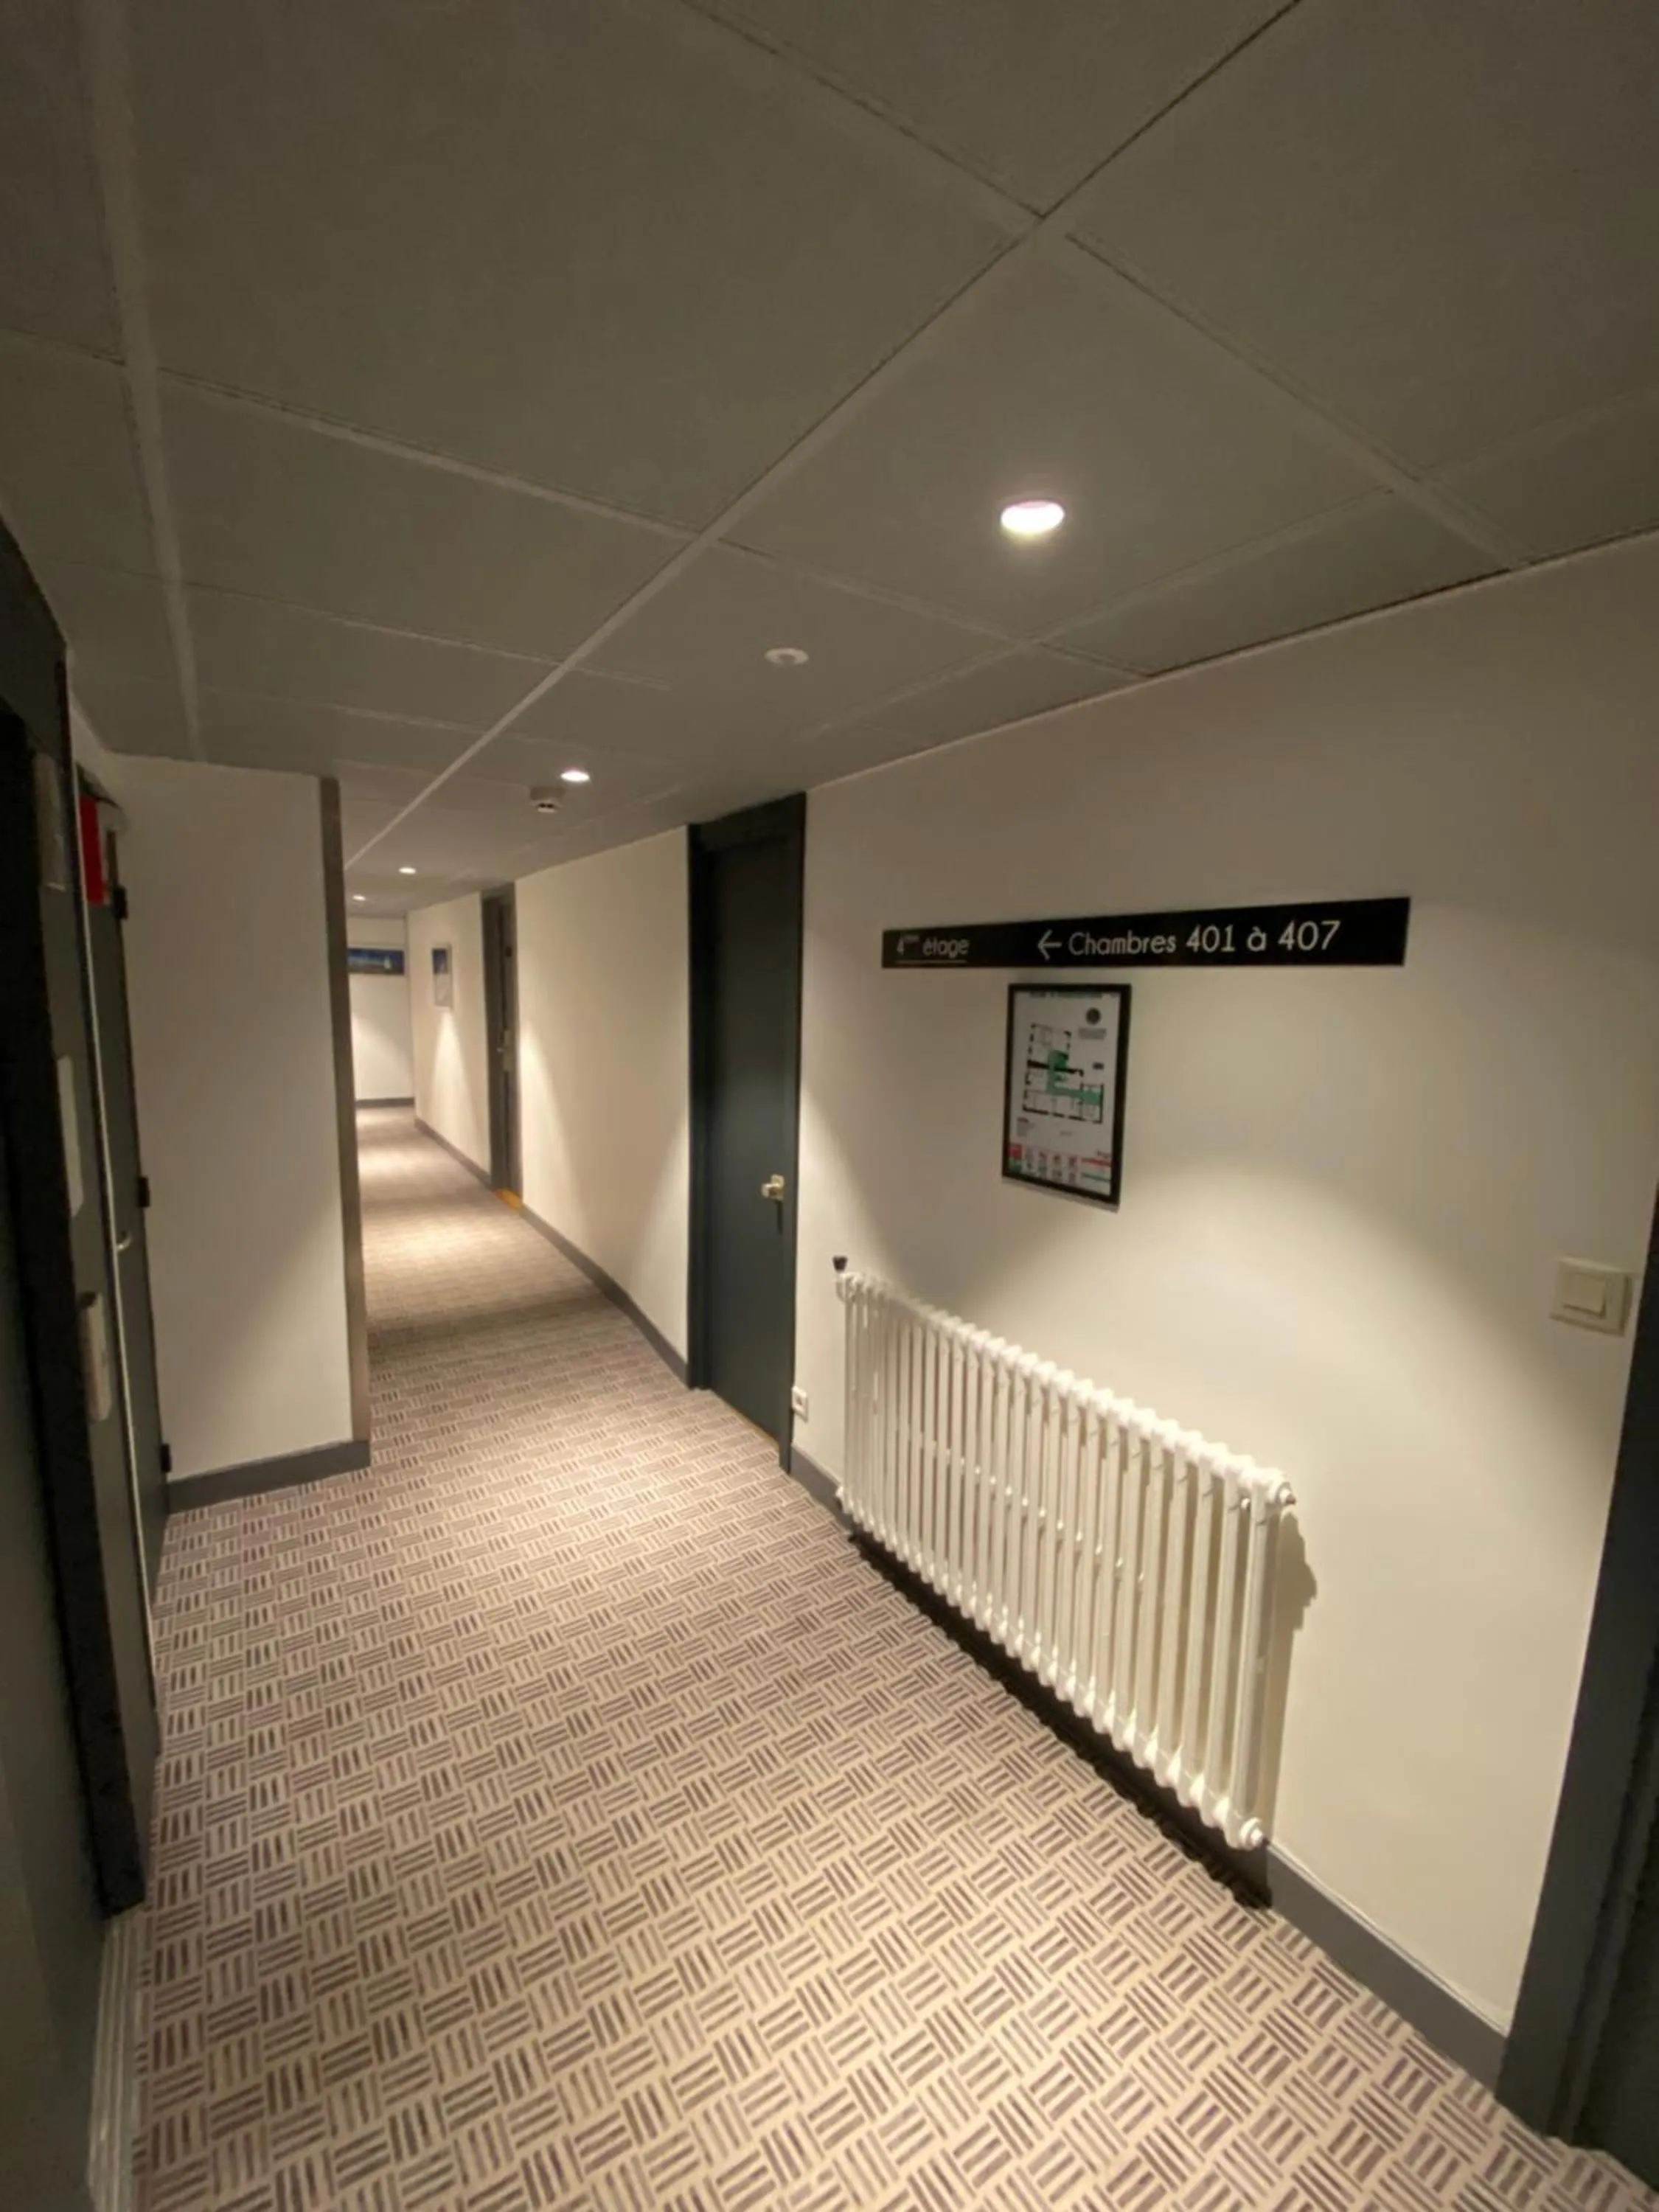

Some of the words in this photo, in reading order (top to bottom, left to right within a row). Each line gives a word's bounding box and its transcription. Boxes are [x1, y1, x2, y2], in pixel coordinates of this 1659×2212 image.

[1068, 929, 1178, 956] Chambres
[1186, 923, 1237, 953] 401
[1246, 925, 1267, 952] à
[1277, 919, 1341, 950] 407
